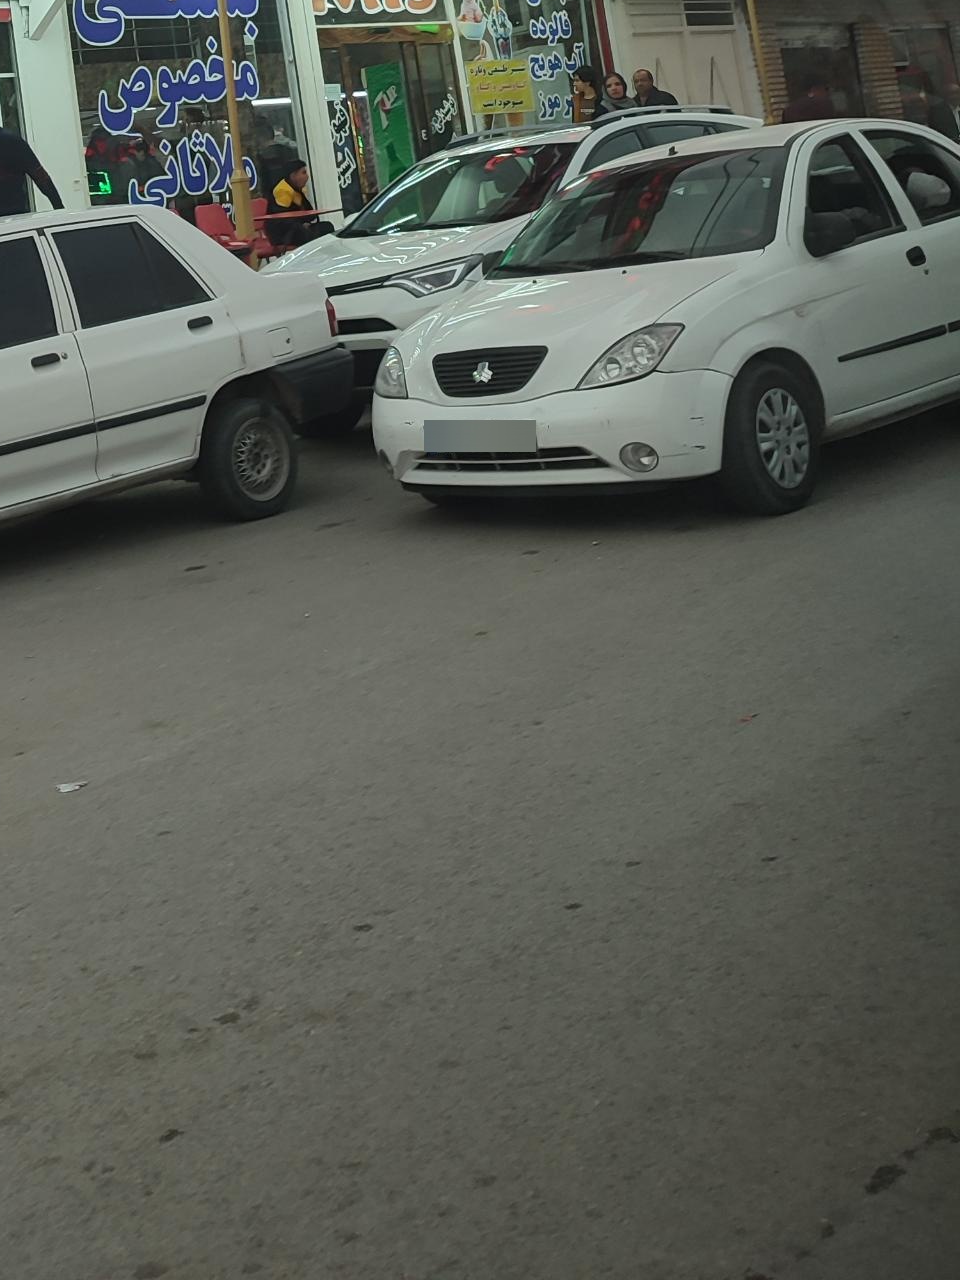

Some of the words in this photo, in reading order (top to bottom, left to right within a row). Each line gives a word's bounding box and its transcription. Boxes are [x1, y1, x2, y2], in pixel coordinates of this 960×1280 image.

[529, 10, 573, 46] فالوده
[98, 36, 259, 135] مخصوص
[528, 51, 564, 82] هویج
[128, 129, 257, 209] ملاثانی
